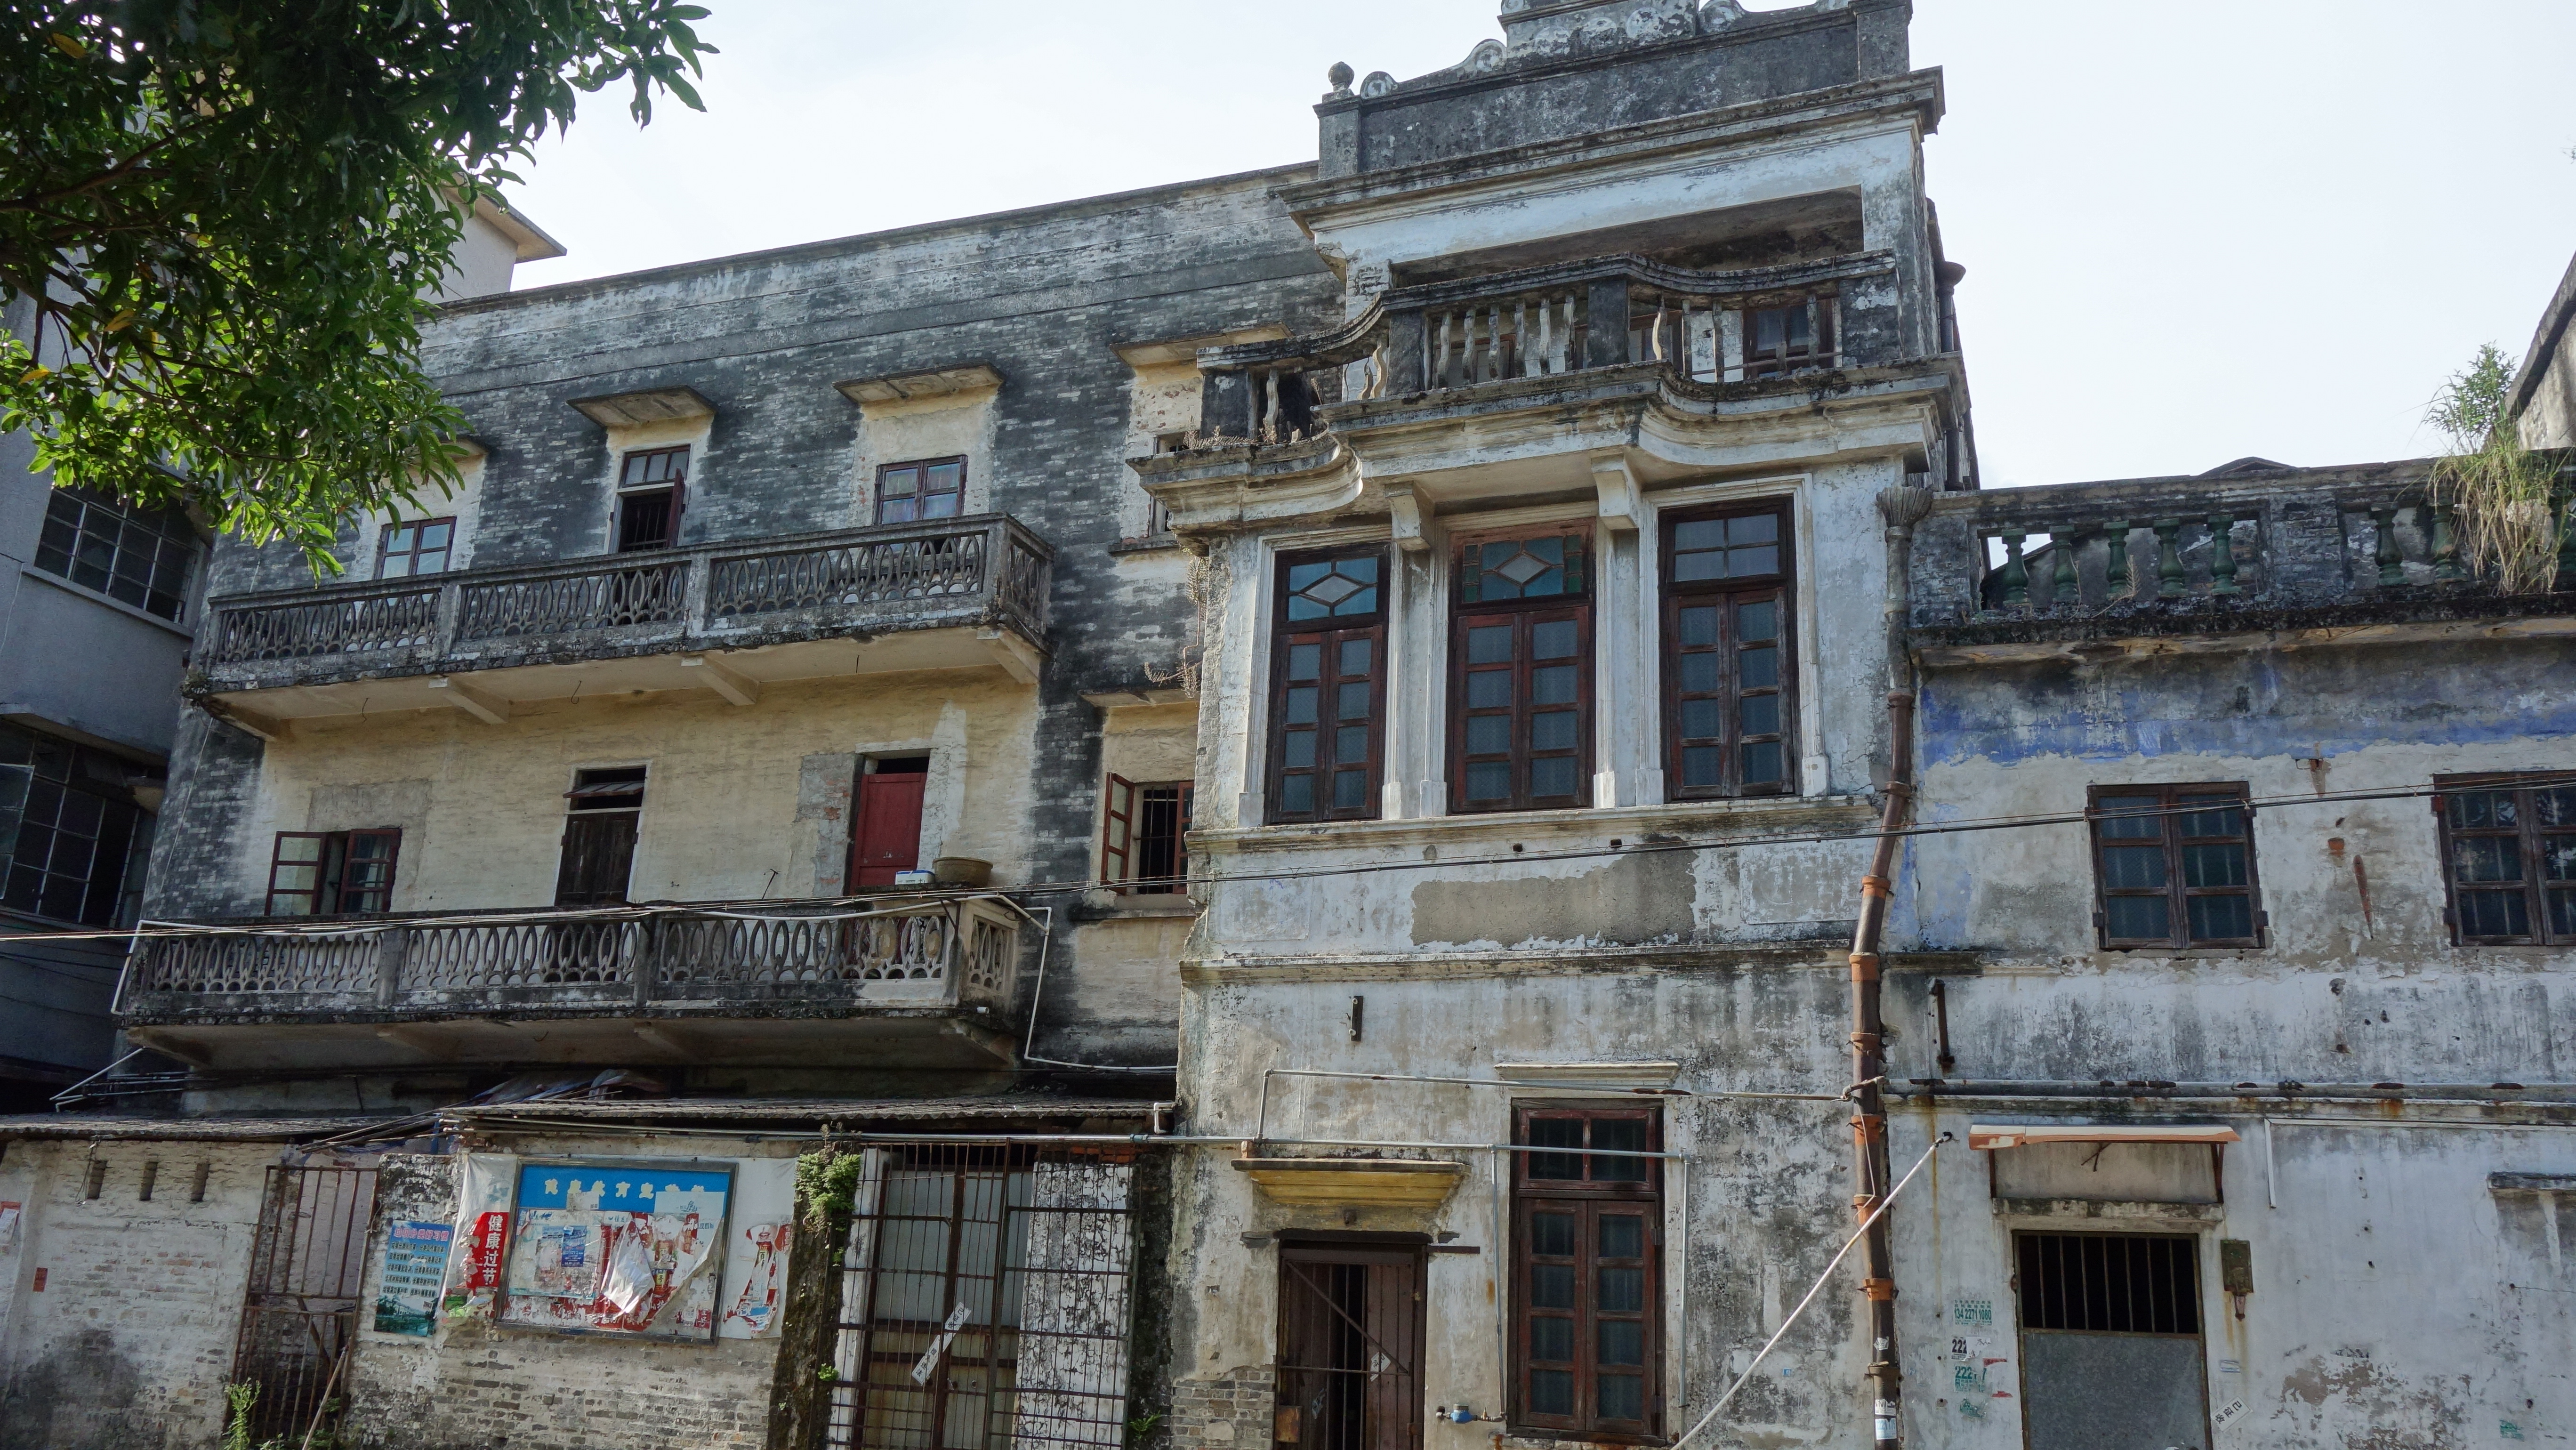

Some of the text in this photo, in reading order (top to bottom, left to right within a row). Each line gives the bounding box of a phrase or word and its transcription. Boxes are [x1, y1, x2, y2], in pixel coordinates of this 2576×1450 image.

[394, 1227, 450, 1242] 垃圾分类好习惯
[482, 1214, 504, 1286] 健康过节
[1954, 1308, 1992, 1320] 134 2271 1080
[2215, 1400, 2242, 1424] 已征收
